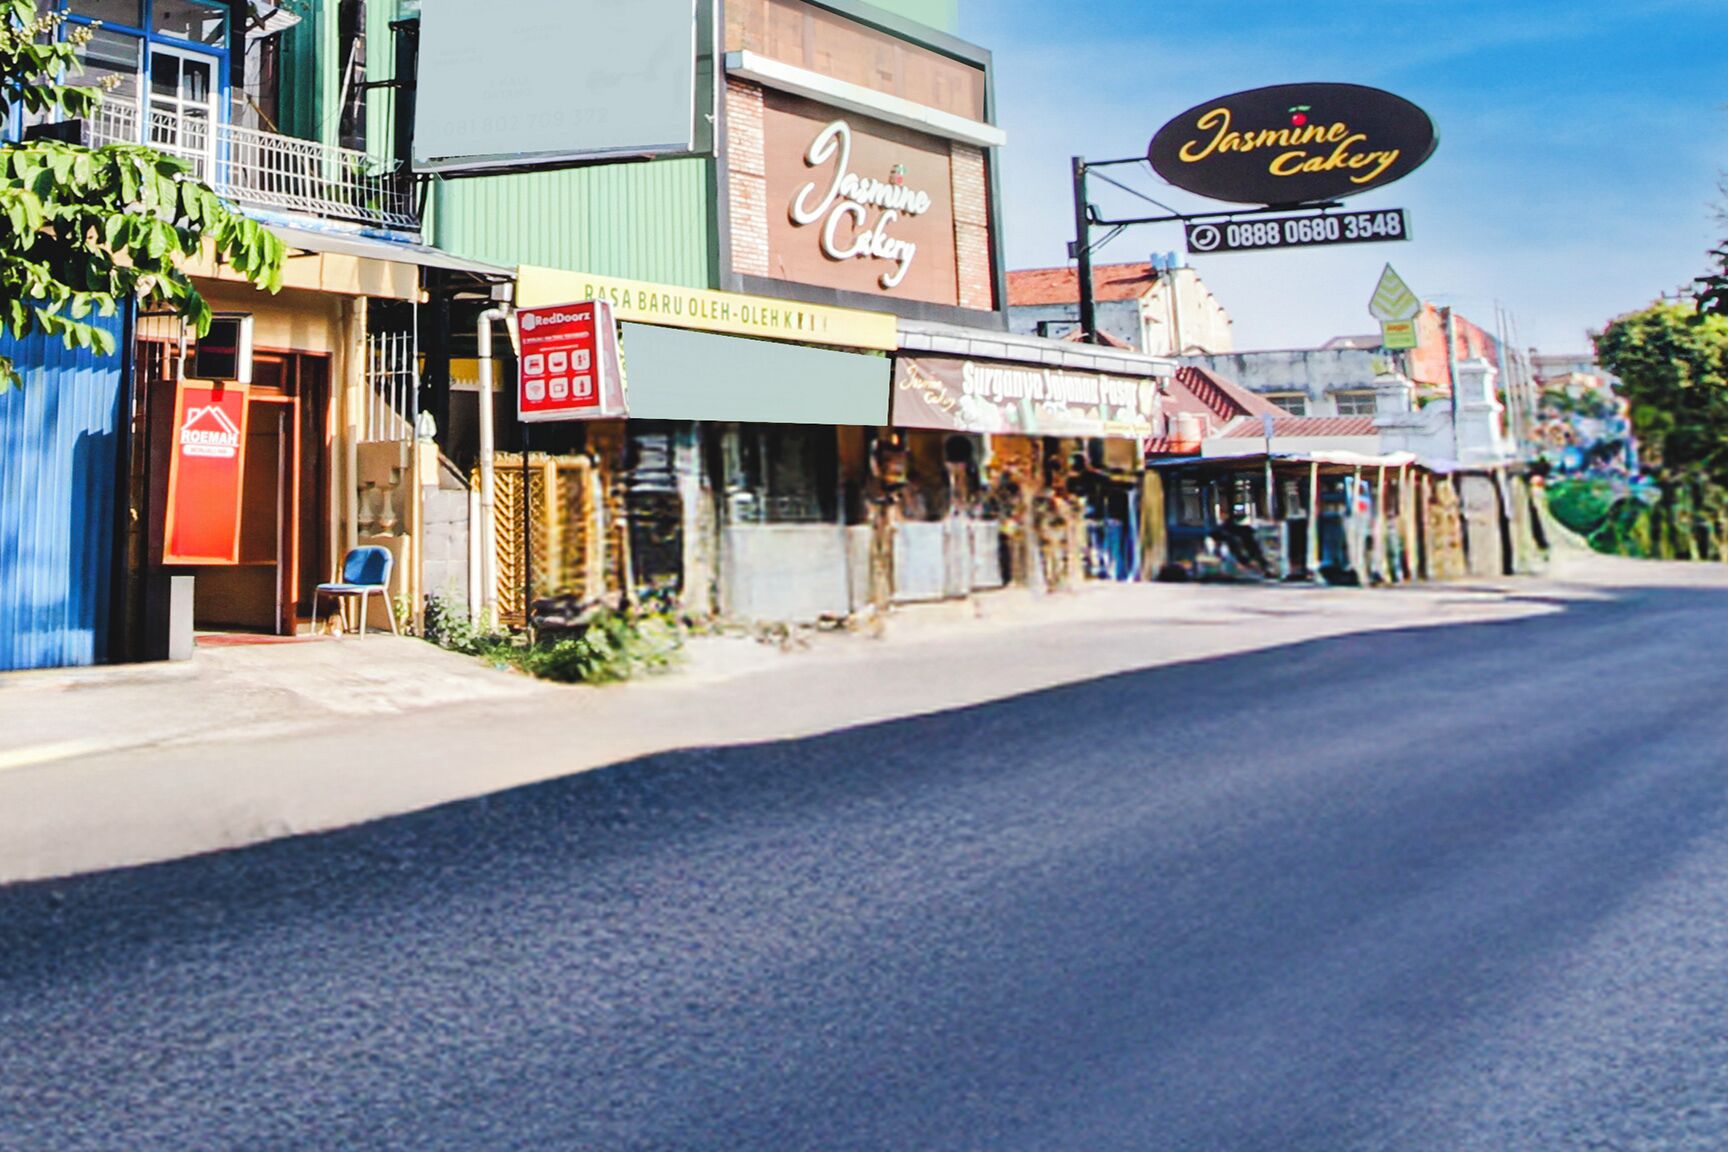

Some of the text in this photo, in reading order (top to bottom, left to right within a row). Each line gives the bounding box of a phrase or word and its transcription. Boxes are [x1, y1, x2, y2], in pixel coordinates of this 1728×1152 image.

[1179, 107, 1350, 162] Jasmine
[791, 119, 932, 225] Jasmine
[1269, 134, 1400, 184] Cakery
[822, 201, 916, 289] Cakery
[1227, 212, 1402, 248] 0888 0680 3548
[535, 312, 591, 326] RedDoorz
[584, 284, 632, 309] RASA
[638, 291, 683, 316] BARU
[688, 297, 779, 327] OLEH-OLEH
[180, 429, 239, 446] ROEMAH
